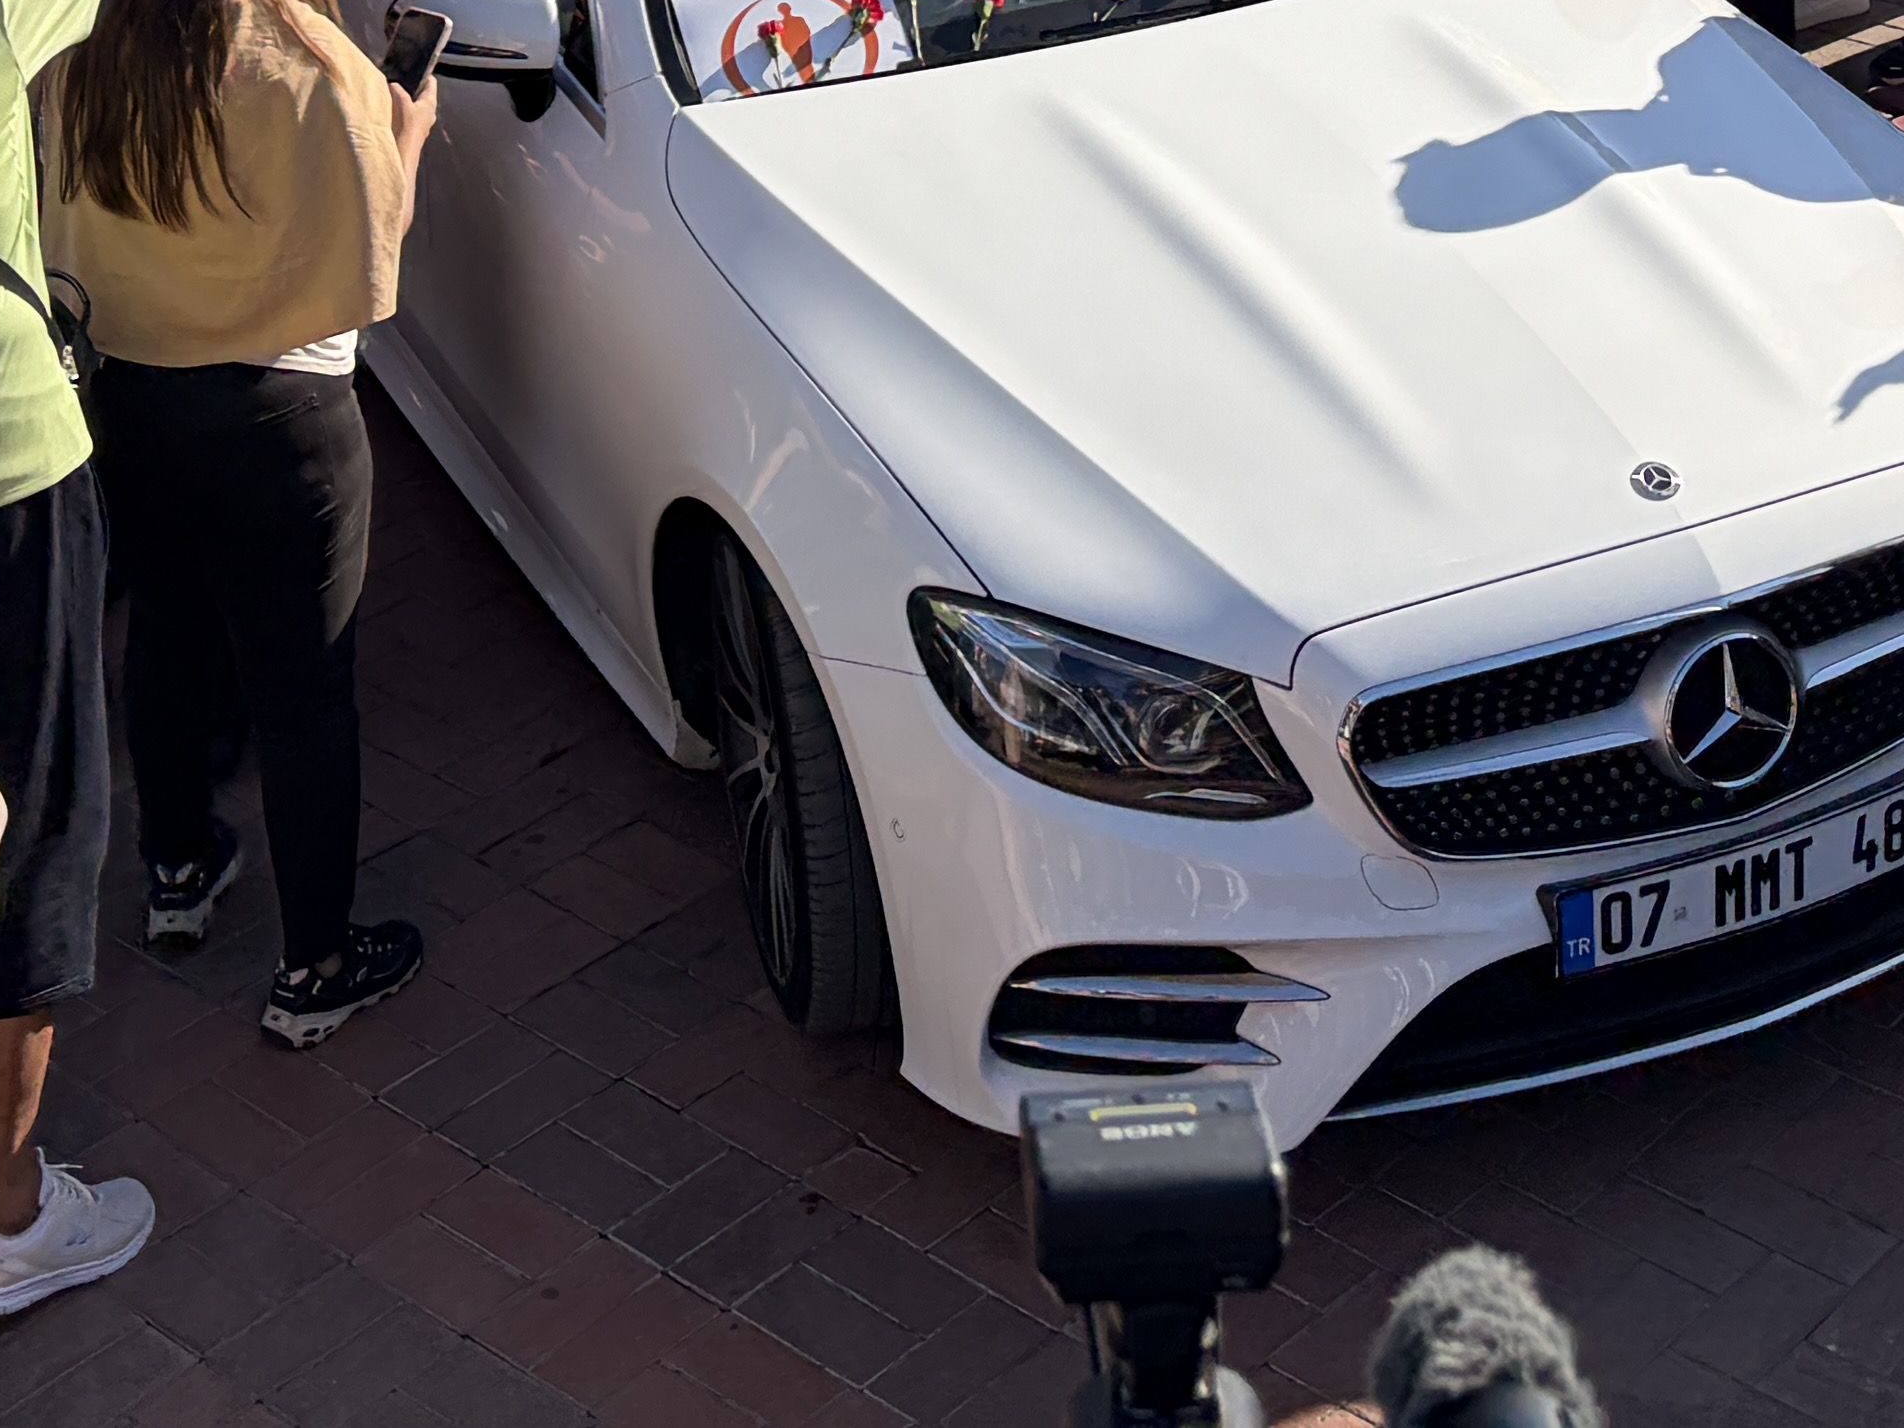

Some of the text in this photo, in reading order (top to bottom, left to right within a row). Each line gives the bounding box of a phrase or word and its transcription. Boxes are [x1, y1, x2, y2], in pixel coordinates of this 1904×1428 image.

[1566, 937, 1591, 959] TR
[1600, 879, 1671, 956] 07
[1714, 836, 1814, 928] MMT
